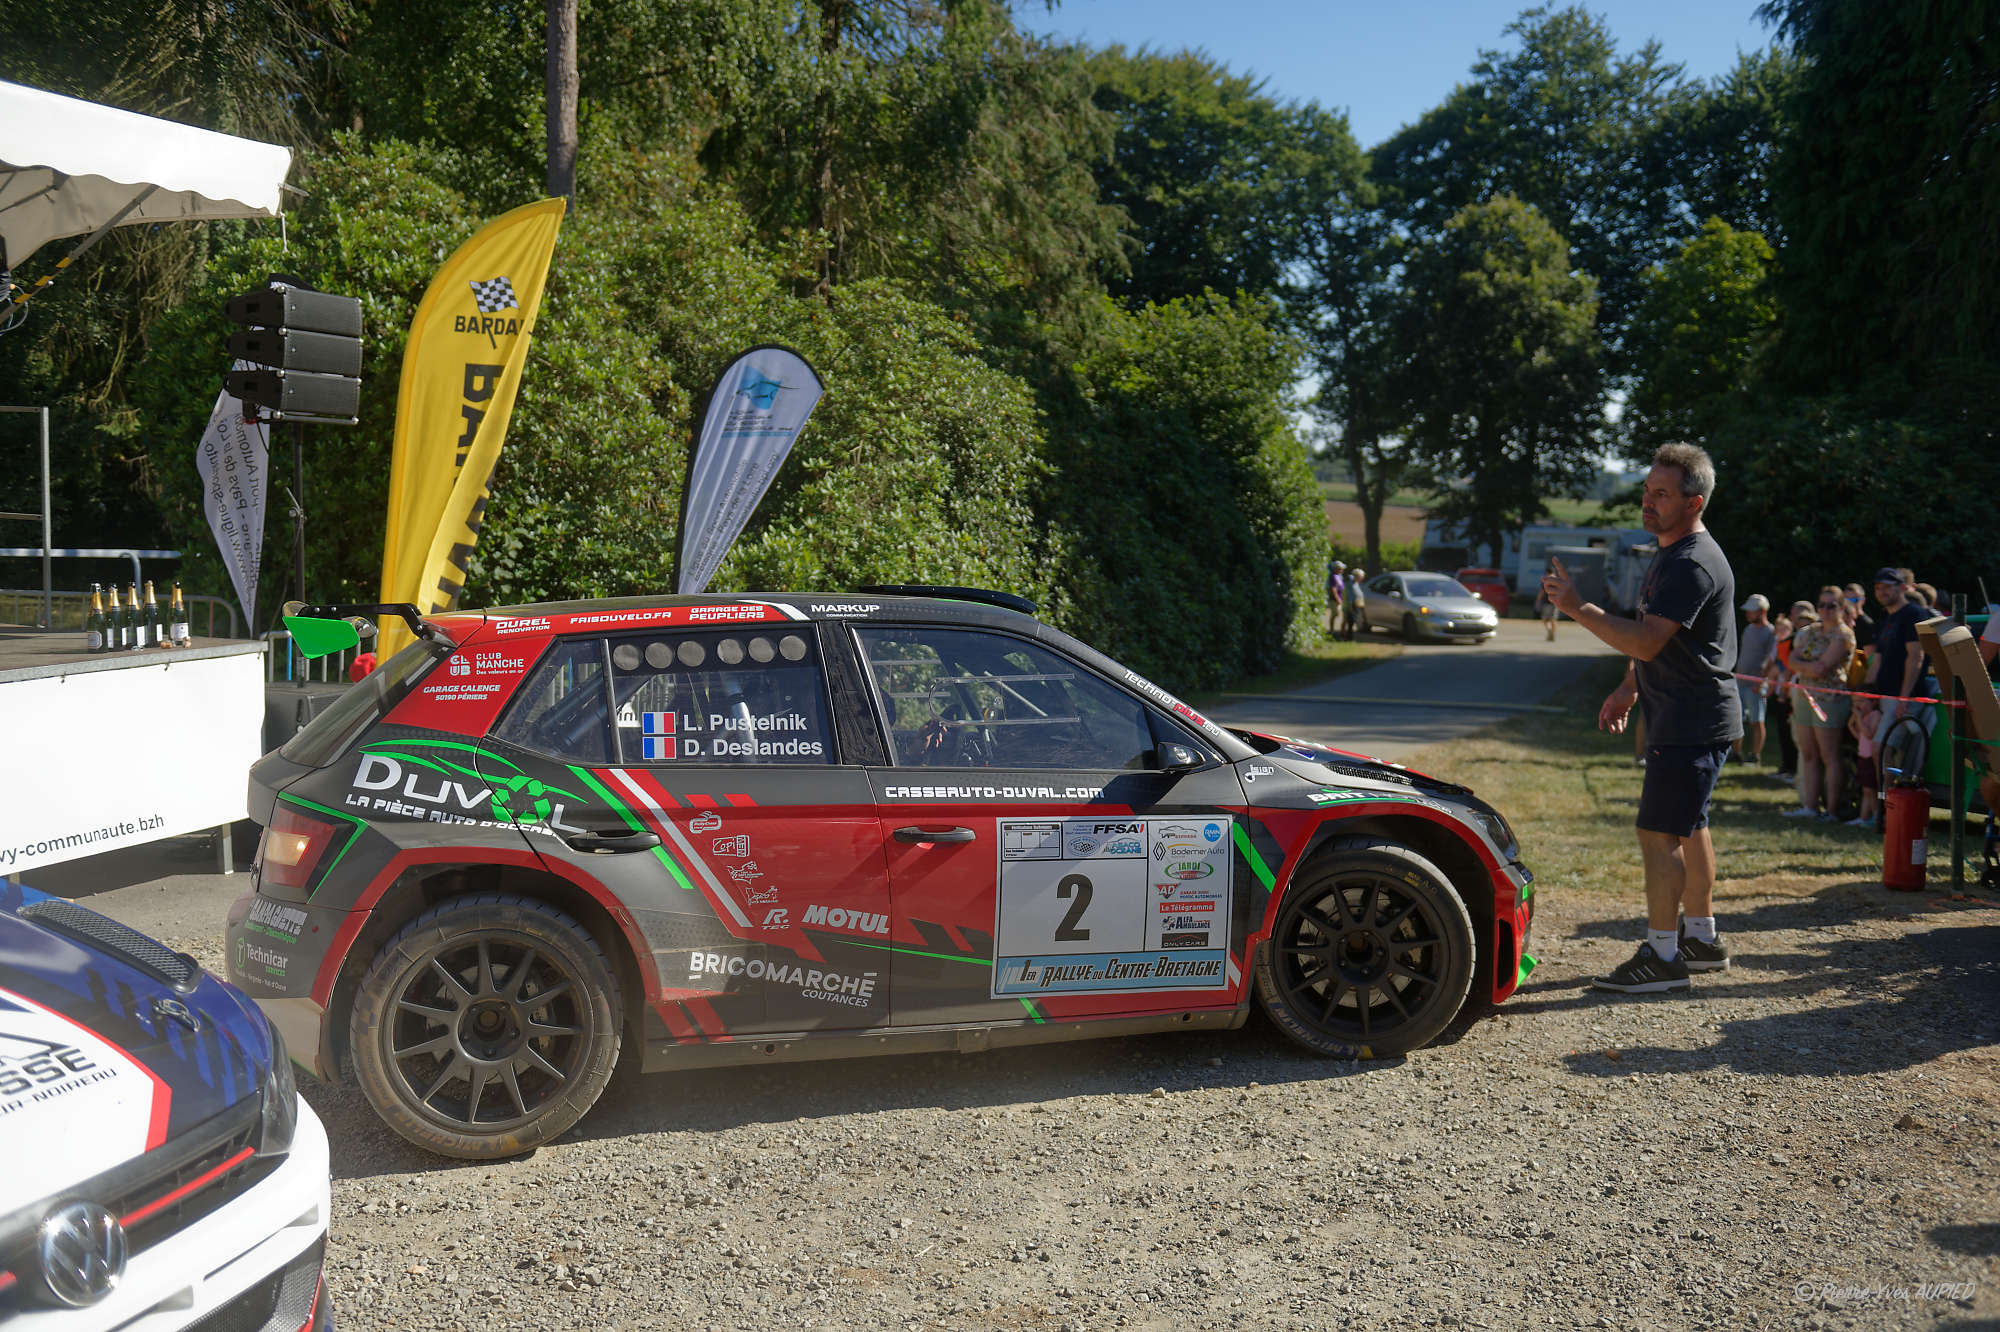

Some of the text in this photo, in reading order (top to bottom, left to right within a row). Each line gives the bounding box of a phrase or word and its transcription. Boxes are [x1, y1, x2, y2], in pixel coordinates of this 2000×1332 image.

[454, 315, 524, 336] BARDA
[689, 612, 764, 620] PEUPLIERS
[811, 604, 880, 612] MARKUP
[496, 618, 550, 630] DUREL
[497, 625, 550, 634] RENOVATION
[476, 652, 502, 660] CLUB
[476, 659, 524, 668] MANCHE
[684, 714, 807, 732] L. Pustelnik
[684, 738, 823, 756] D. Deslandes
[345, 794, 370, 808] LA
[373, 799, 426, 819] PIÈCE
[429, 810, 477, 826] AUTO
[1093, 824, 1138, 834] FFSA
[1054, 874, 1094, 942] 2
[1170, 904, 1212, 912] Télégramme
[802, 904, 890, 934] MOTUL
[247, 943, 288, 968] Technicar
[690, 951, 878, 998] BRICOMARCHÉ
[1040, 964, 1093, 987] RALLYE
[1092, 970, 1104, 980] DU
[1104, 956, 1222, 980] CENTRE-BRETAGNE
[802, 988, 869, 1008] COUTANCES
